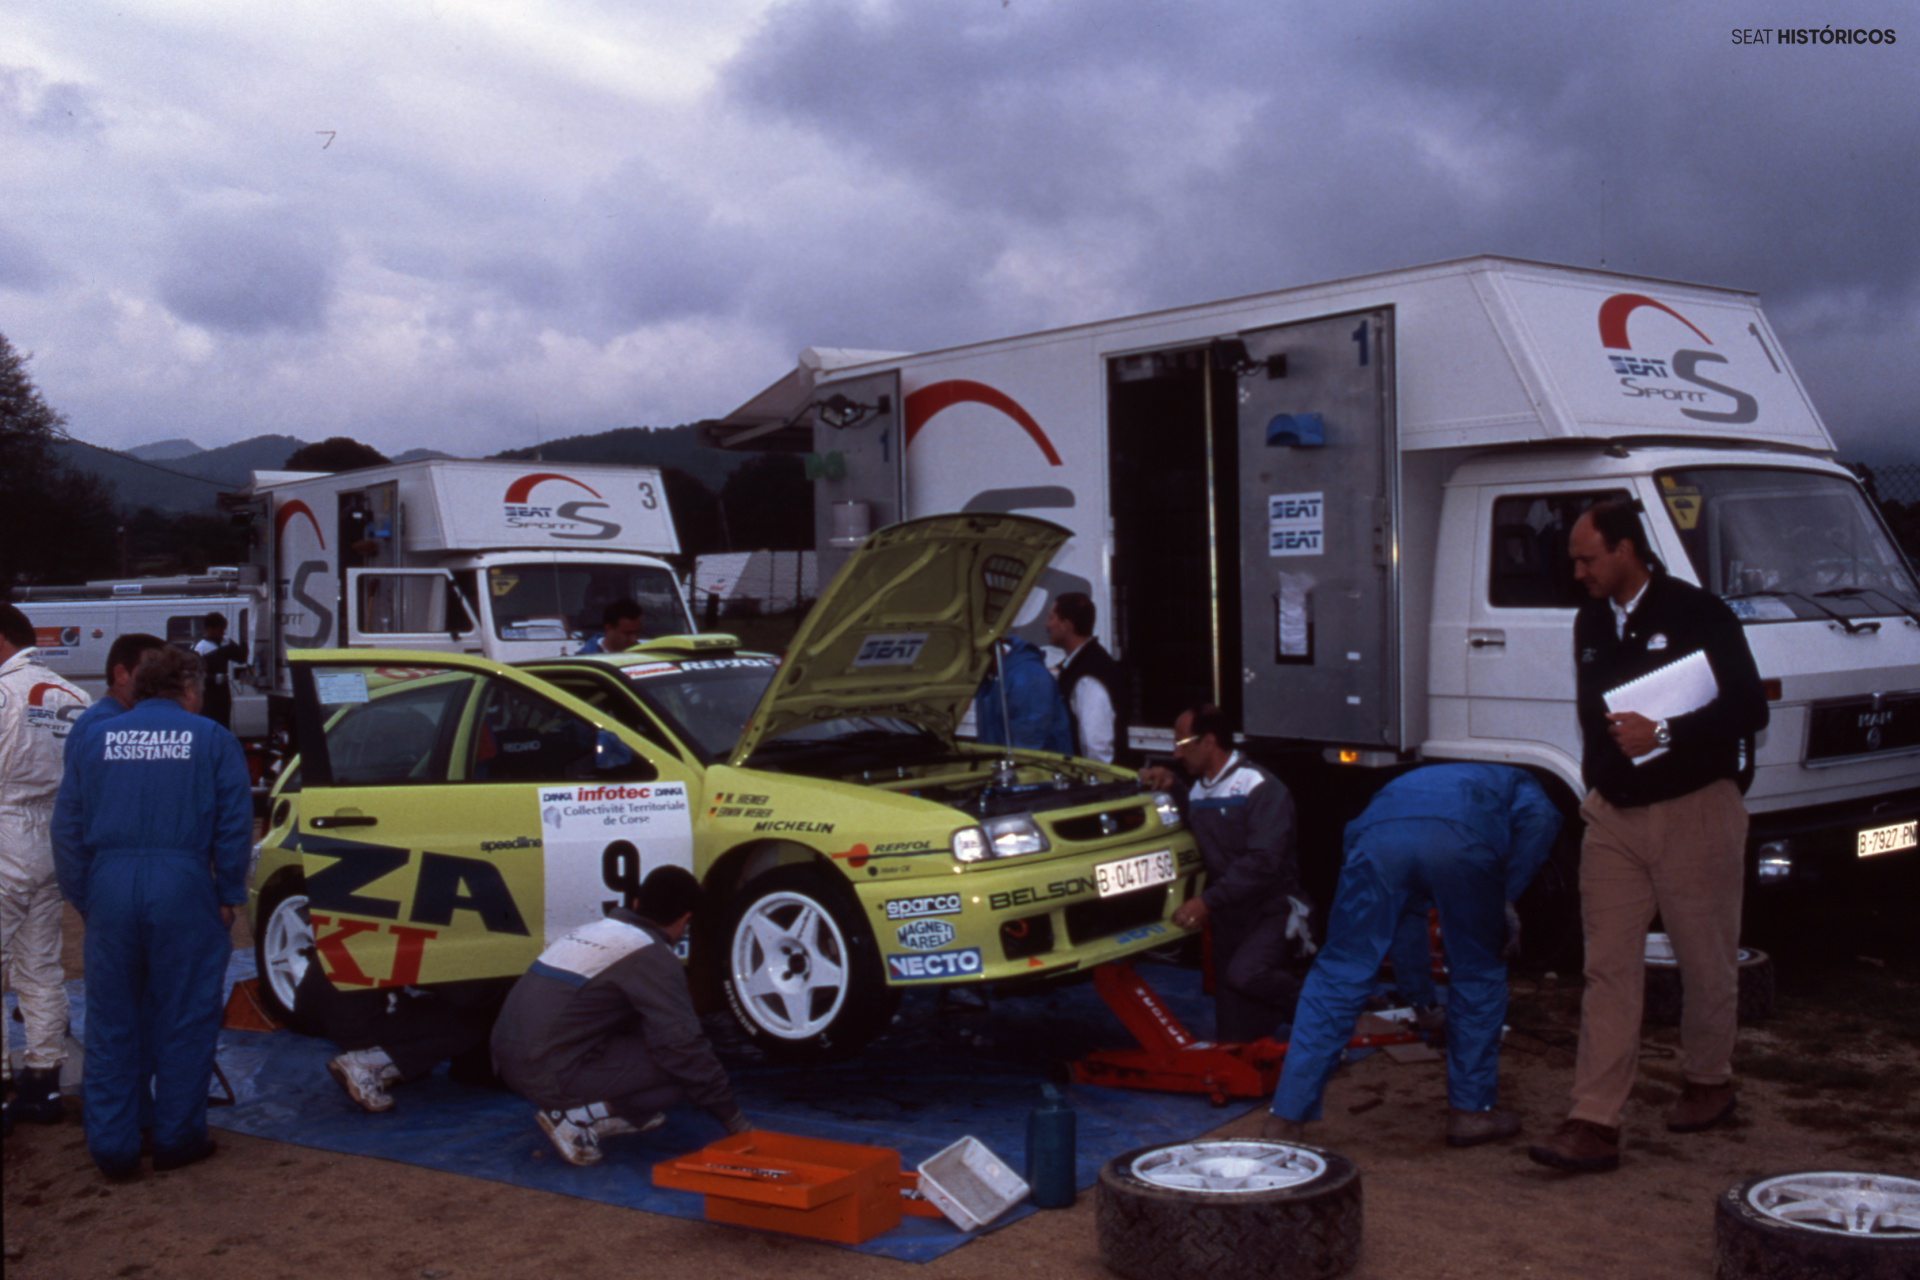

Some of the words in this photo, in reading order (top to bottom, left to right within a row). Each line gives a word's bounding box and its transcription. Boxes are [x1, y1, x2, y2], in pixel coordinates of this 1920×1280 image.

[1351, 319, 1368, 367] 1
[1748, 322, 1782, 373] 1
[1607, 355, 1668, 378] SEAT
[880, 427, 890, 463] 1
[638, 481, 658, 510] 3
[503, 506, 552, 517] SEAT
[1271, 499, 1321, 518] SEAT
[1271, 530, 1321, 549] SEAT
[857, 639, 924, 661] SEAT
[680, 658, 767, 671] REPSOL
[105, 730, 193, 746] POZZALLO
[104, 745, 191, 760] ASSISTANCE
[577, 785, 651, 802] infotec
[563, 803, 625, 817] Collectivité
[628, 800, 686, 814] Territoriale
[603, 816, 616, 826] de
[619, 814, 650, 825] Corse
[753, 821, 835, 834] MICHELIN
[480, 835, 543, 853] speedline
[873, 840, 931, 852] REPSOL
[602, 839, 641, 919] 9
[989, 877, 1096, 911] BELSON
[886, 895, 960, 919] sparco
